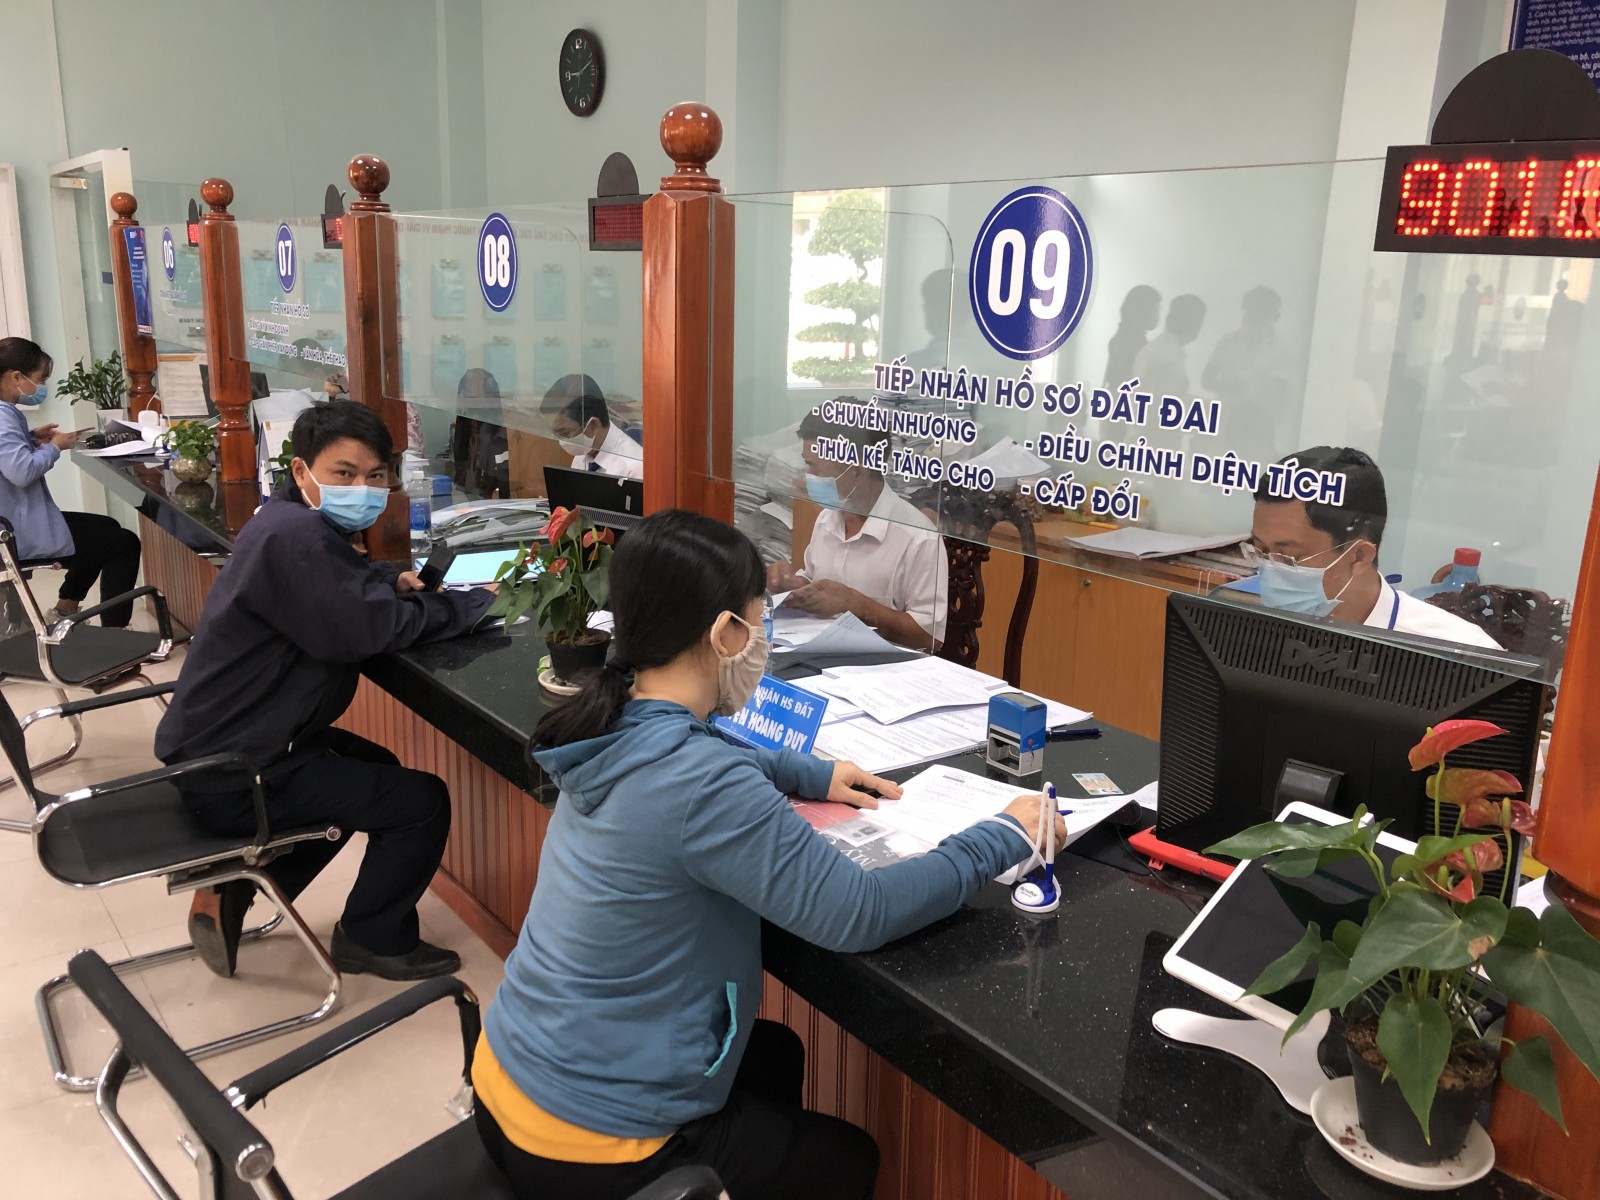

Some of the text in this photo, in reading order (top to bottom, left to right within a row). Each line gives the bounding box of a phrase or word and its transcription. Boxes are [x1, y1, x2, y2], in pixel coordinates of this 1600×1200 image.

[163, 240, 174, 269] 06
[278, 239, 293, 277] 07
[484, 234, 510, 288] 08
[987, 228, 1071, 320] 09
[874, 355, 1219, 434] TIẾP NHẬN HỒ SƠ ĐẤT ĐAI
[822, 397, 888, 431] CHUYỂN
[892, 411, 977, 445] NHƯỢNG
[863, 441, 888, 475] KẾ,
[892, 449, 943, 482] TẶNG
[948, 463, 994, 490] CHO
[1039, 424, 1090, 463] ĐIỀU
[1099, 438, 1183, 478] CHỈNH
[1192, 451, 1258, 495] DIỆN
[1268, 461, 1344, 504] TÍCH
[1036, 473, 1086, 508] CẤP
[1092, 479, 1139, 519] ĐỔI
[1282, 637, 1379, 684] DELL
[780, 696, 794, 711] HS
[794, 701, 815, 719] ĐẤT
[783, 728, 808, 752] DUY
